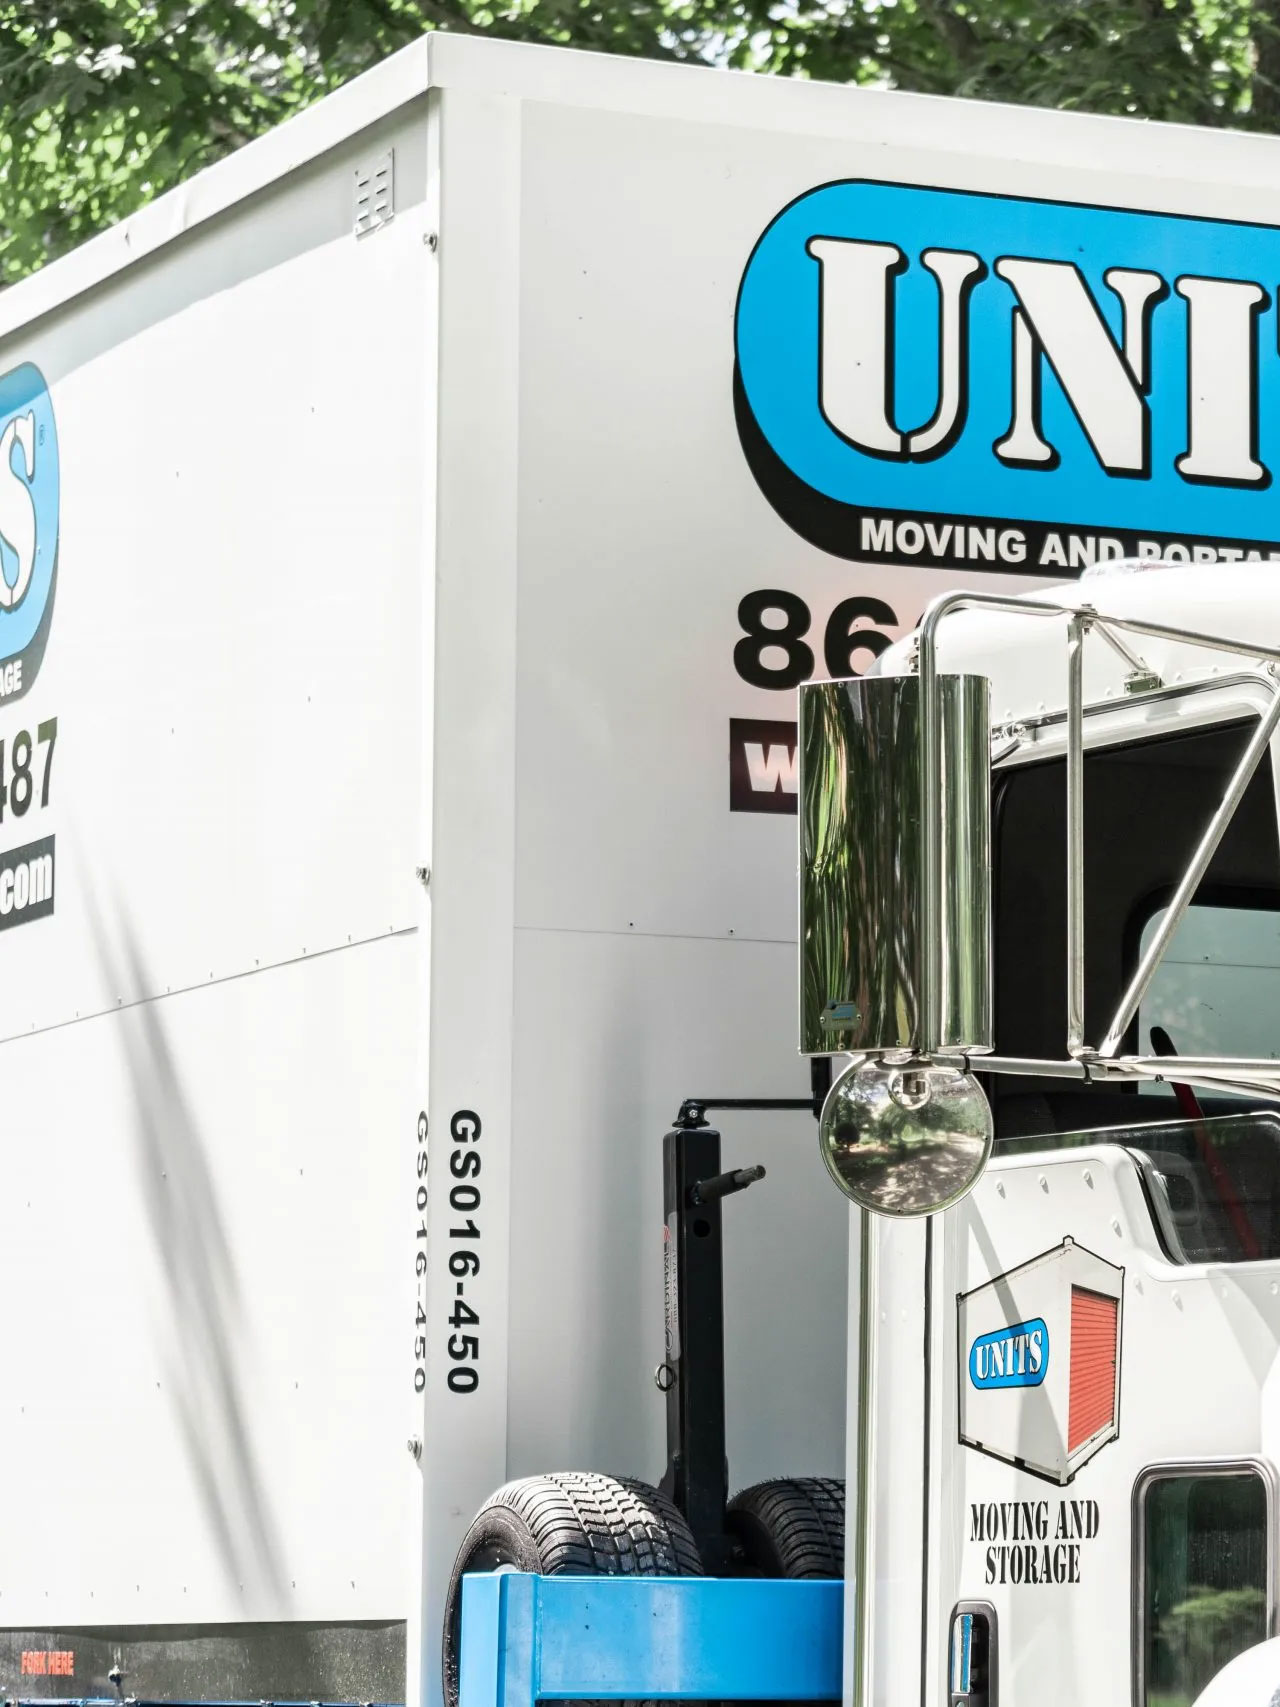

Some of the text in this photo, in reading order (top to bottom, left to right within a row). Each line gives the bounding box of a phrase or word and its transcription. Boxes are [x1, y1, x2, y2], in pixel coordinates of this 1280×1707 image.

[861, 516, 1027, 564] MOVING
[1038, 532, 1125, 570] AND
[414, 1110, 429, 1393] GS016-450
[447, 1109, 482, 1393] GS016-450
[975, 1328, 1043, 1381] UNITS
[970, 1500, 1100, 1542] MOVING AND
[985, 1543, 1081, 1585] STORAGE
[21, 1651, 74, 1676] FORK HERE
